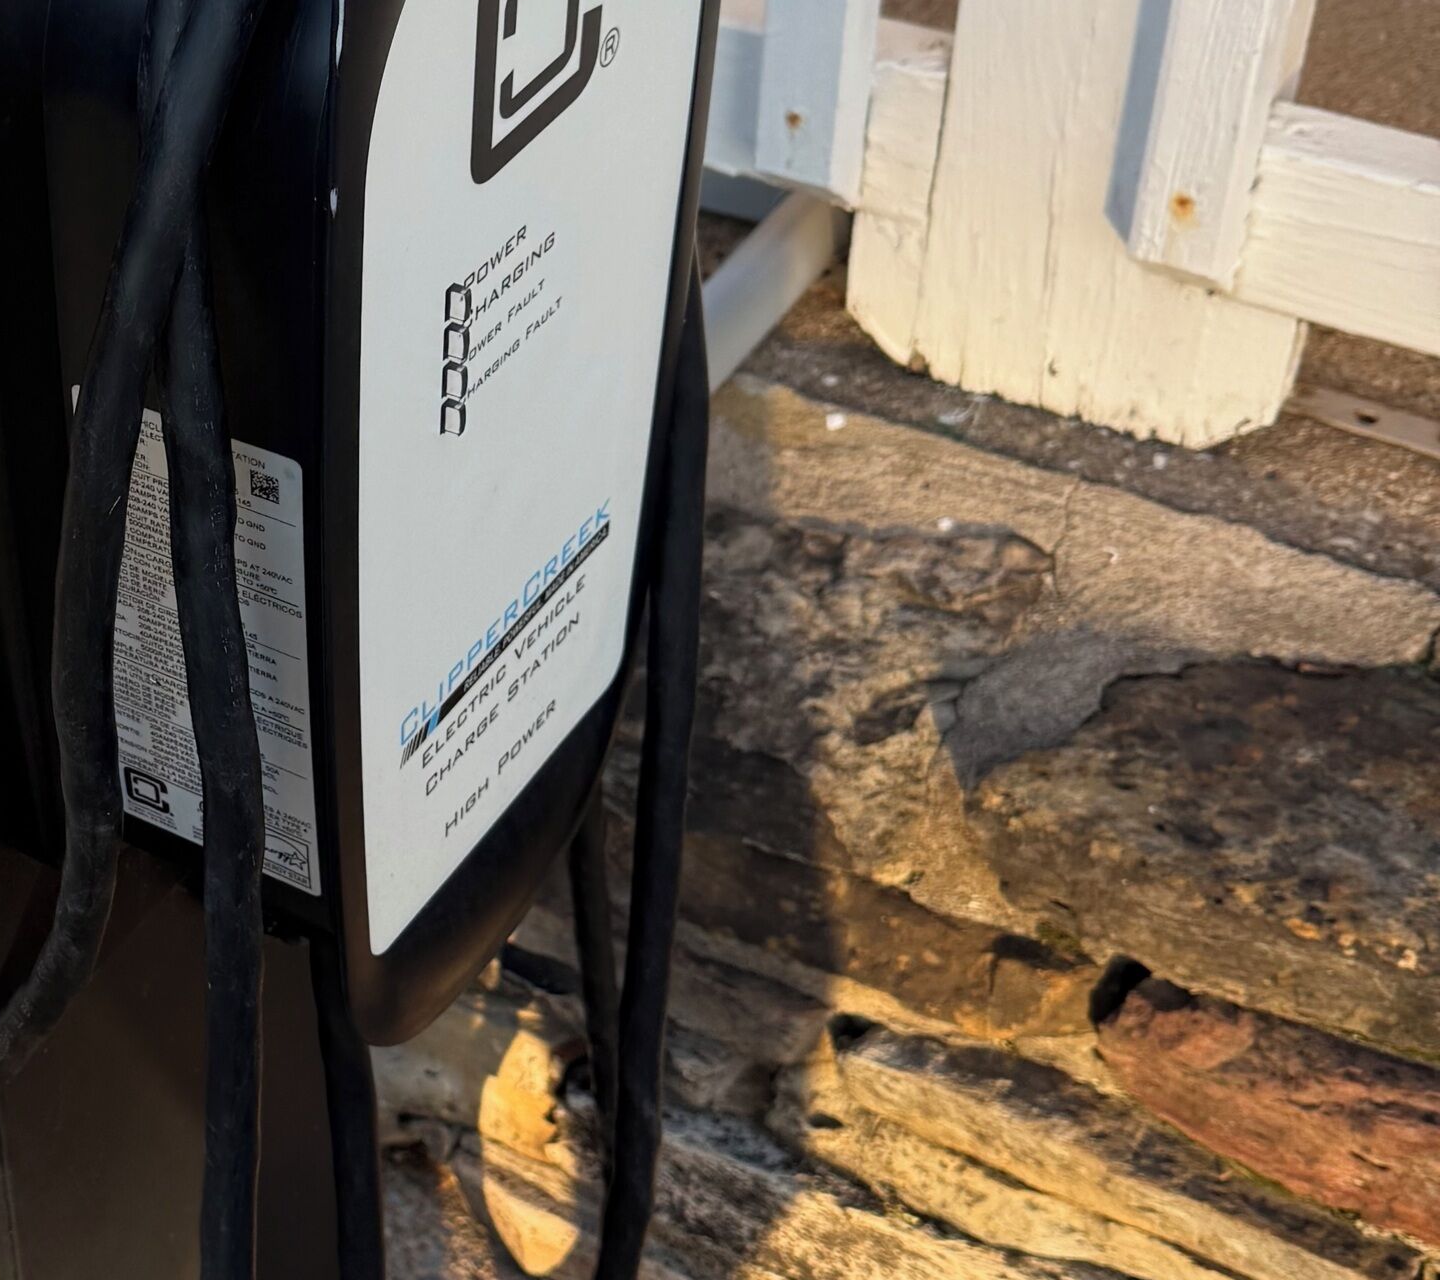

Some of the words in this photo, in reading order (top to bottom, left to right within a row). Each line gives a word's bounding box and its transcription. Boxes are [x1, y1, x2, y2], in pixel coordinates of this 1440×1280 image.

[463, 224, 527, 290] POWER
[463, 321, 503, 365] OWER
[507, 278, 545, 324] FAULT
[465, 338, 521, 403] HARGING
[525, 296, 563, 342] FAULT
[422, 664, 506, 769] ELECTRIC
[514, 574, 586, 660] VEHICLE
[425, 704, 499, 797] CHARGE
[507, 611, 581, 703] STATION
[444, 782, 489, 838] HIGH
[497, 699, 556, 775] POWER
